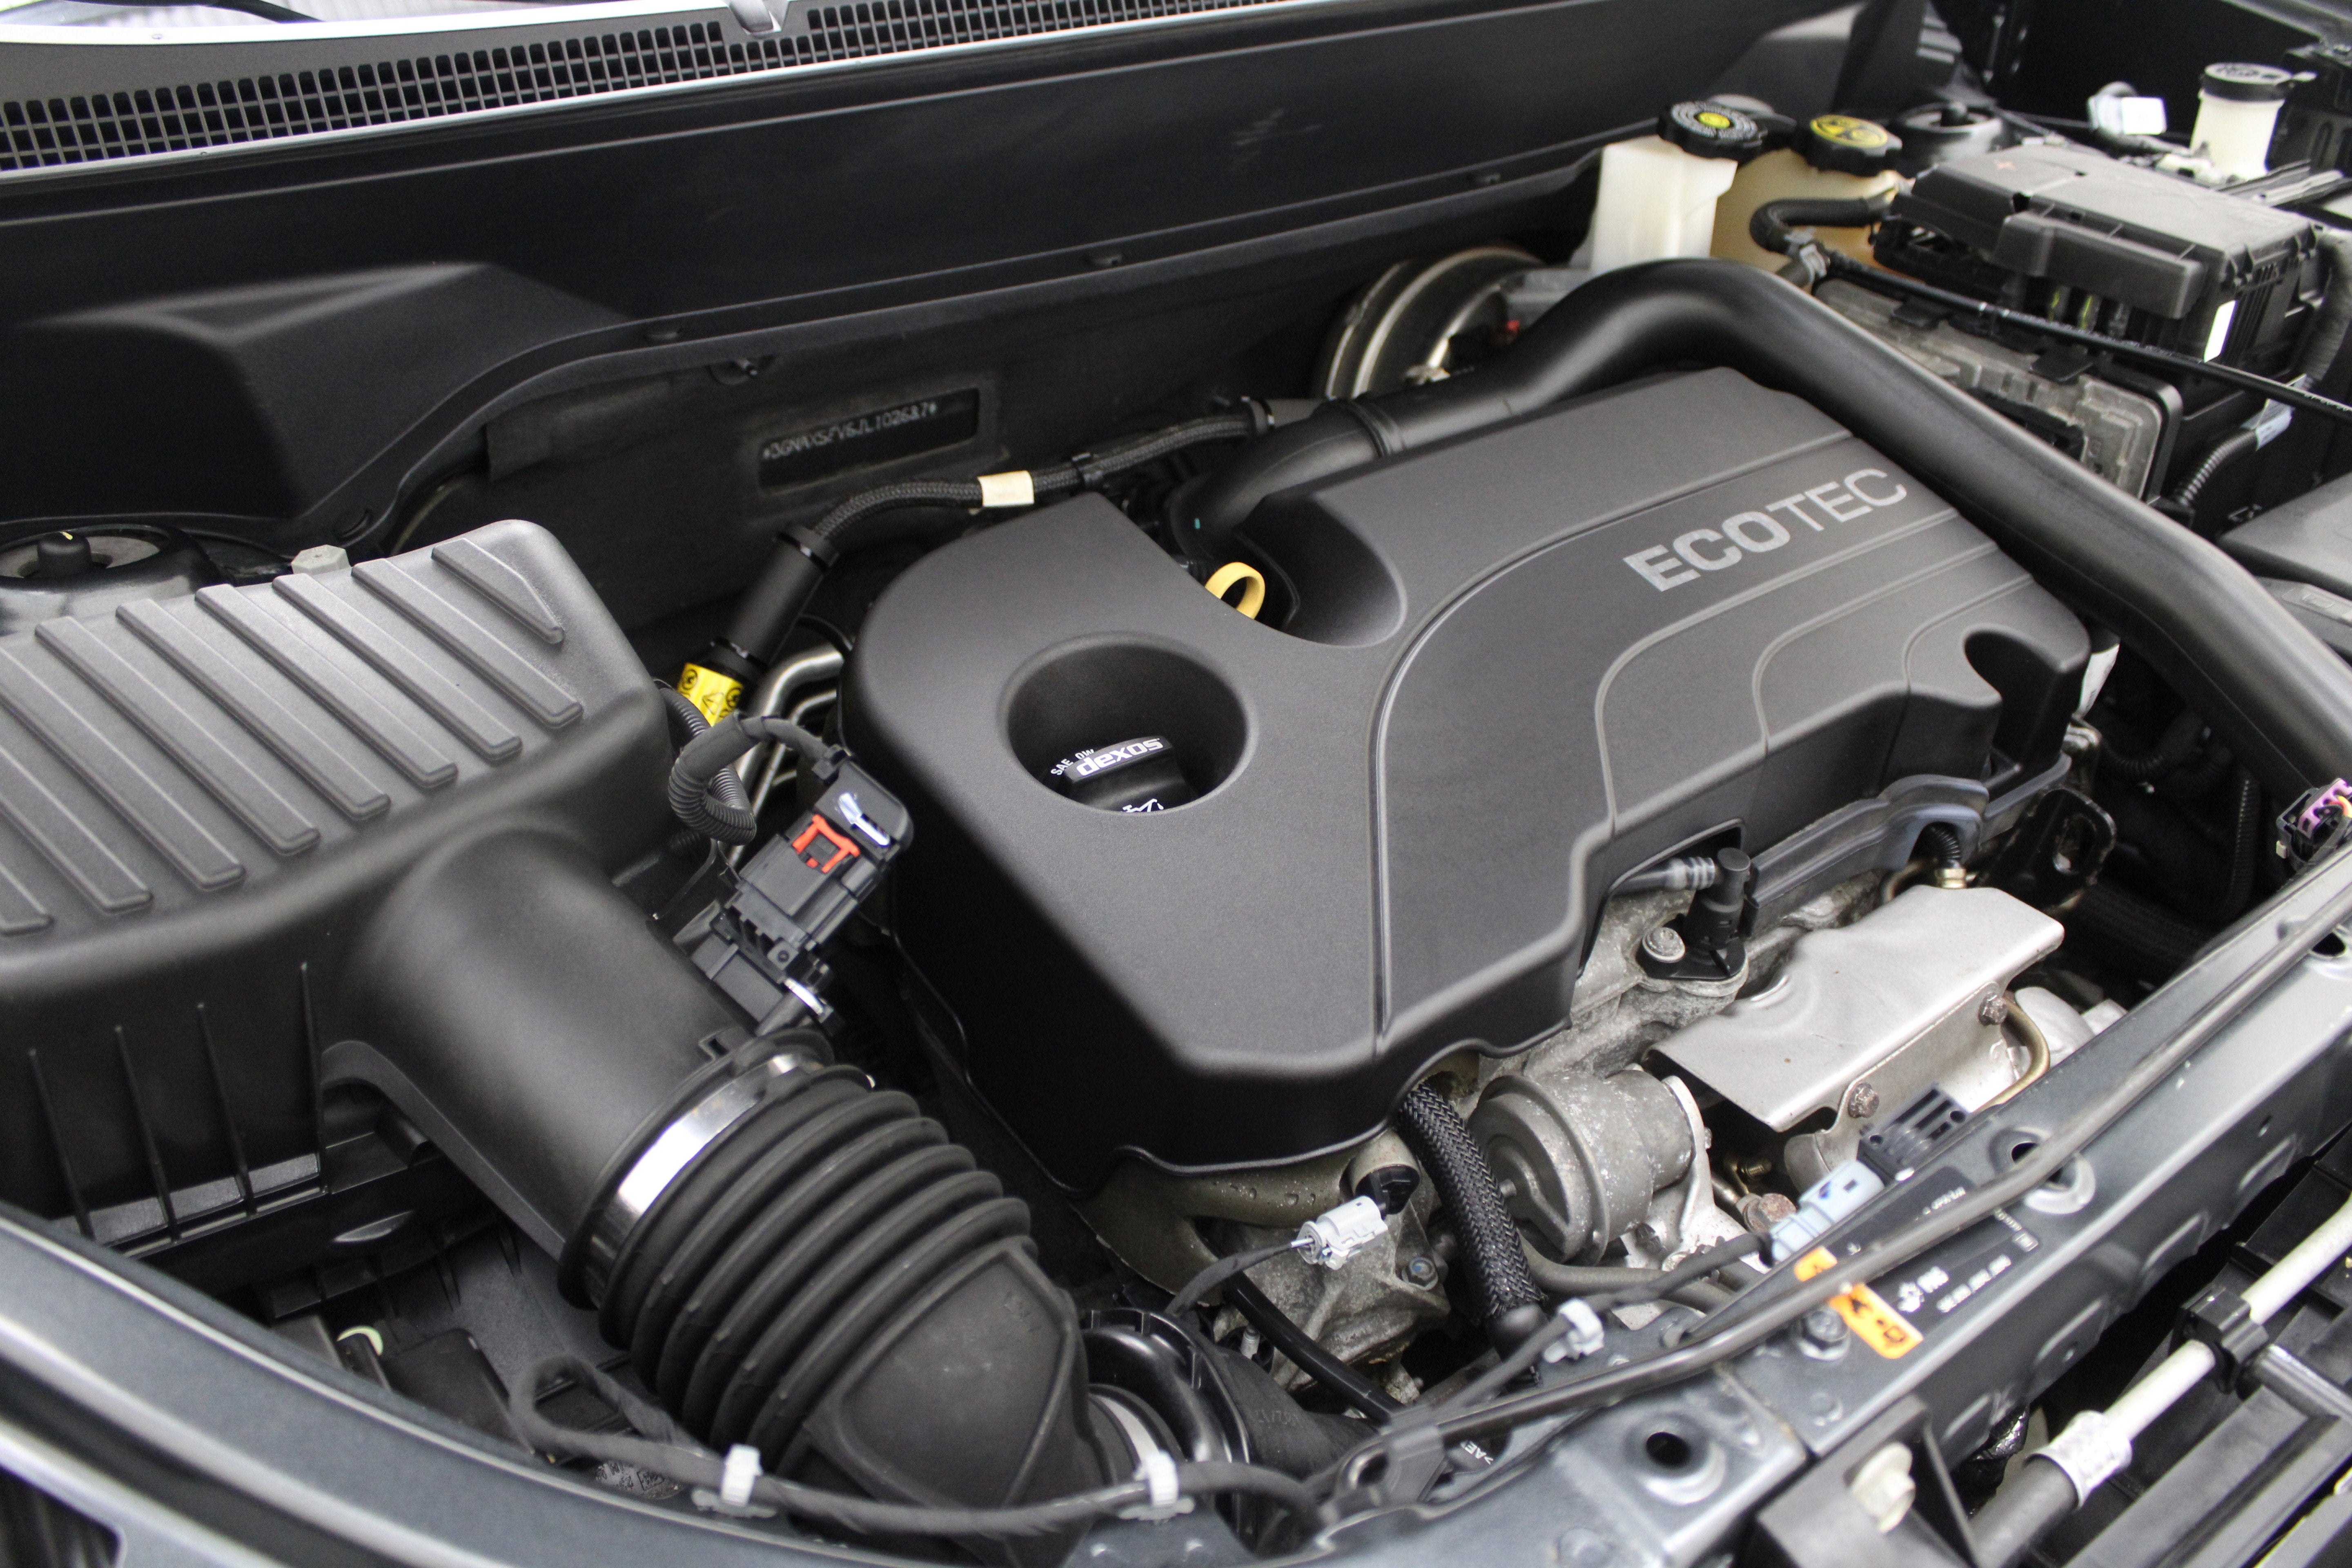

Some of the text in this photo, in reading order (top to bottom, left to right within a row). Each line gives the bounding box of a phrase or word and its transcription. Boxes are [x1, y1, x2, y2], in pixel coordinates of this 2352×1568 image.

[1623, 468, 1908, 592] ECOTEC
[1050, 758, 1074, 775] SAE
[1076, 738, 1163, 776] dexos
